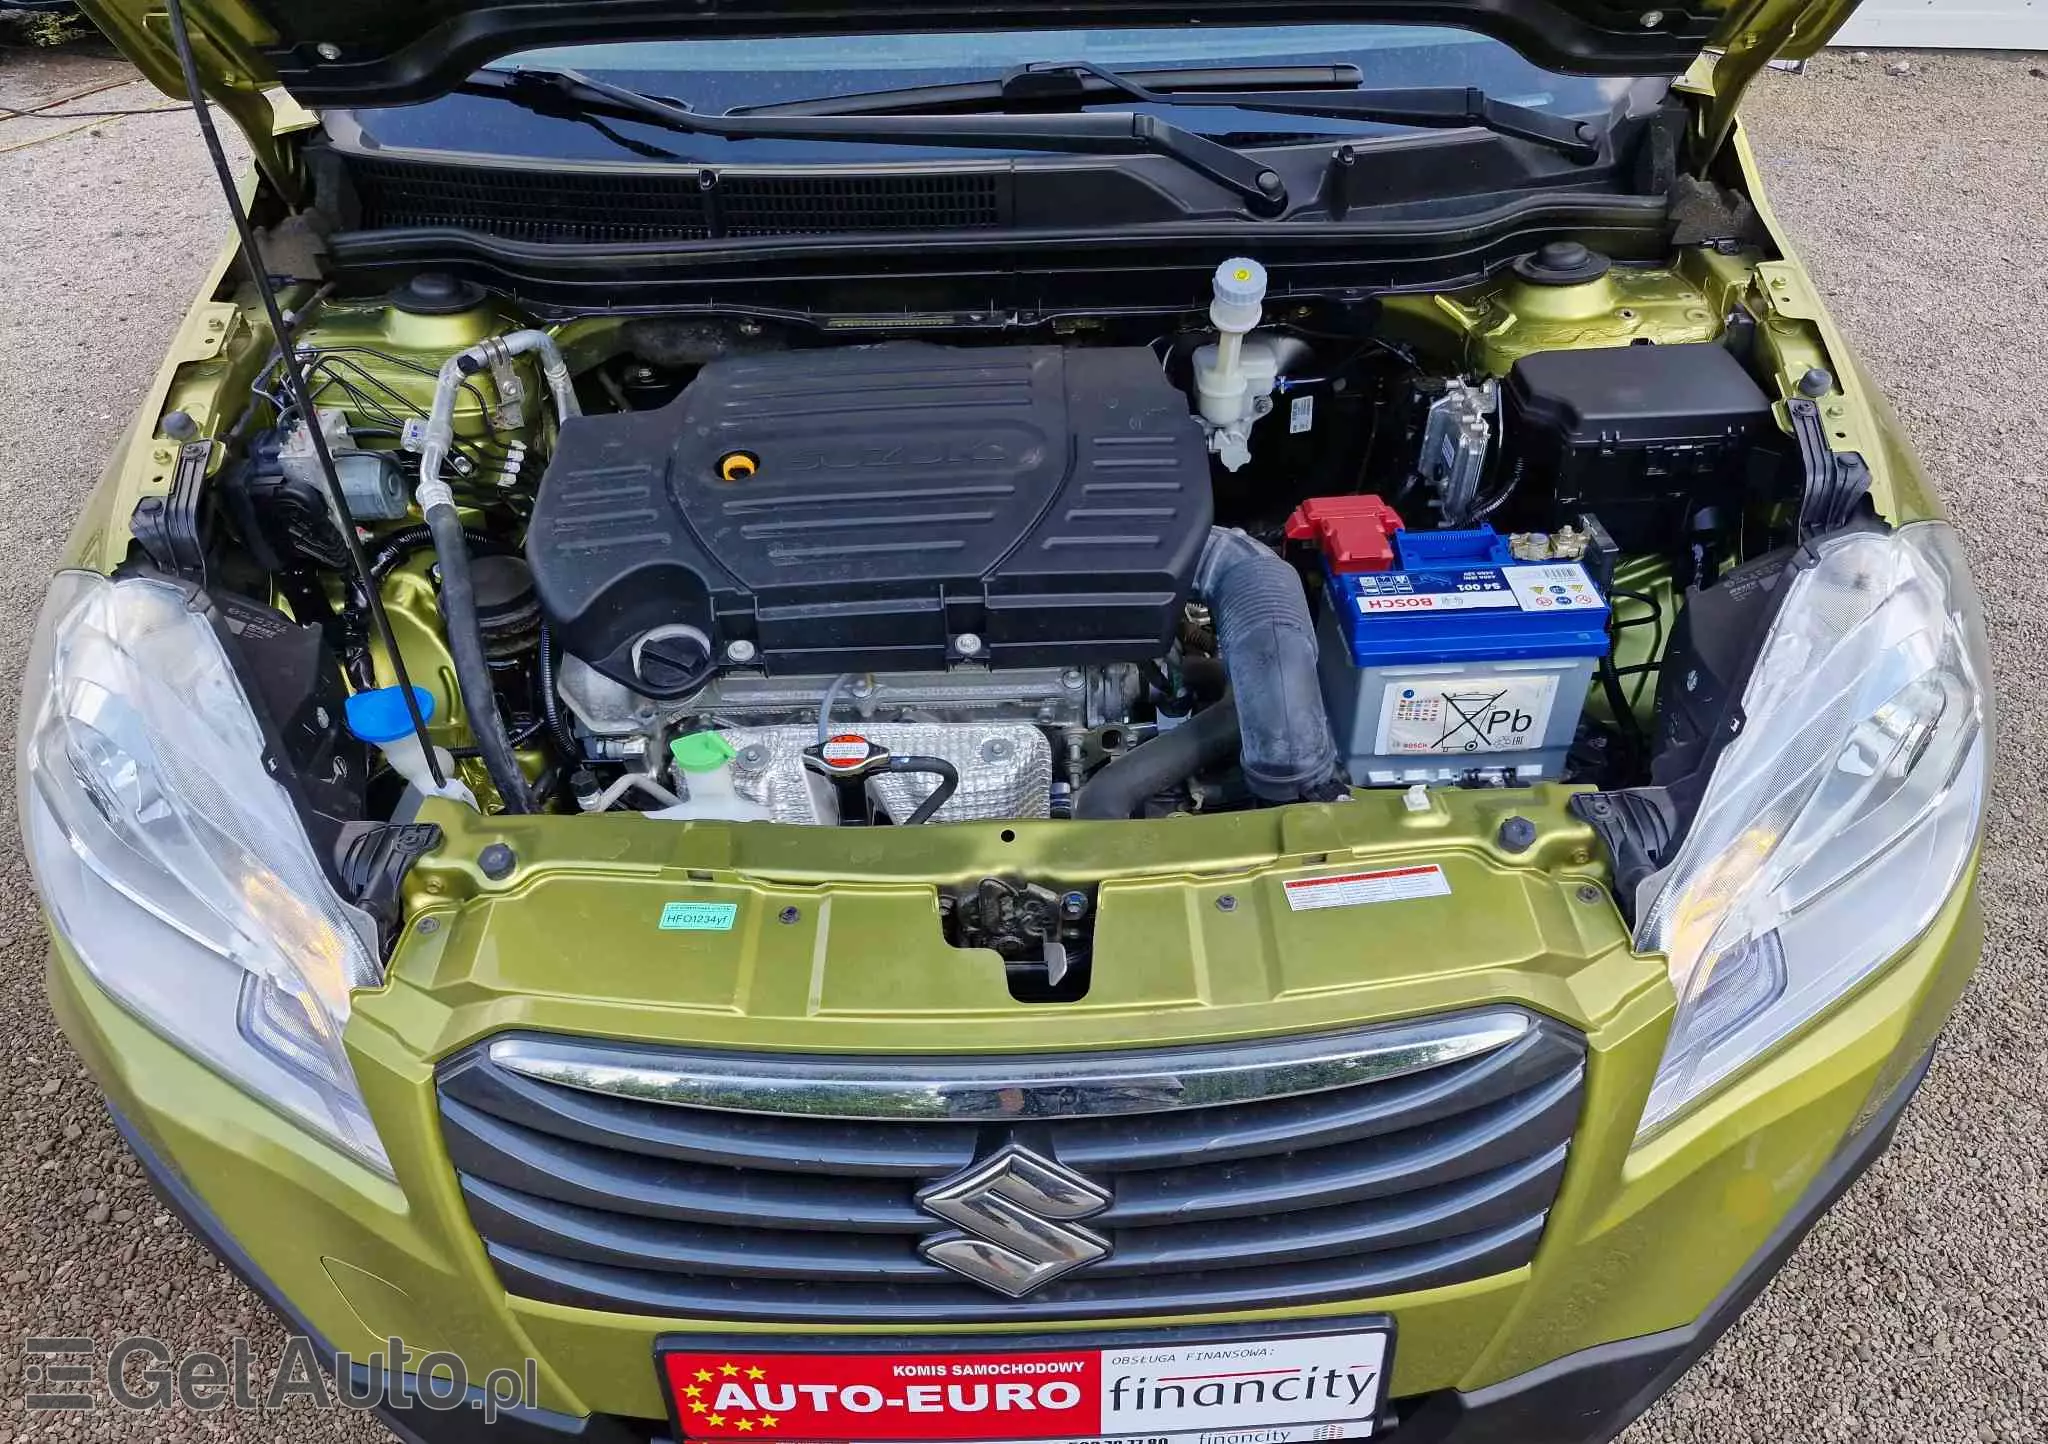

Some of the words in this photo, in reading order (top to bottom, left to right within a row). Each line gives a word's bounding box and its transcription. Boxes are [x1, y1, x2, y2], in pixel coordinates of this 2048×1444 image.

[1368, 597, 1433, 609] BOSCH
[1486, 709, 1533, 735] Pb
[667, 914, 729, 925] HFO1234yf
[1111, 1354, 1177, 1366] OBSŁUGA
[1186, 1348, 1276, 1362] FINANSOWA:
[893, 1364, 947, 1377] KOMIS
[951, 1361, 1085, 1377] SAMOCHODOWY
[713, 1381, 1082, 1413] AUTO-EURO
[1109, 1366, 1377, 1411] financity
